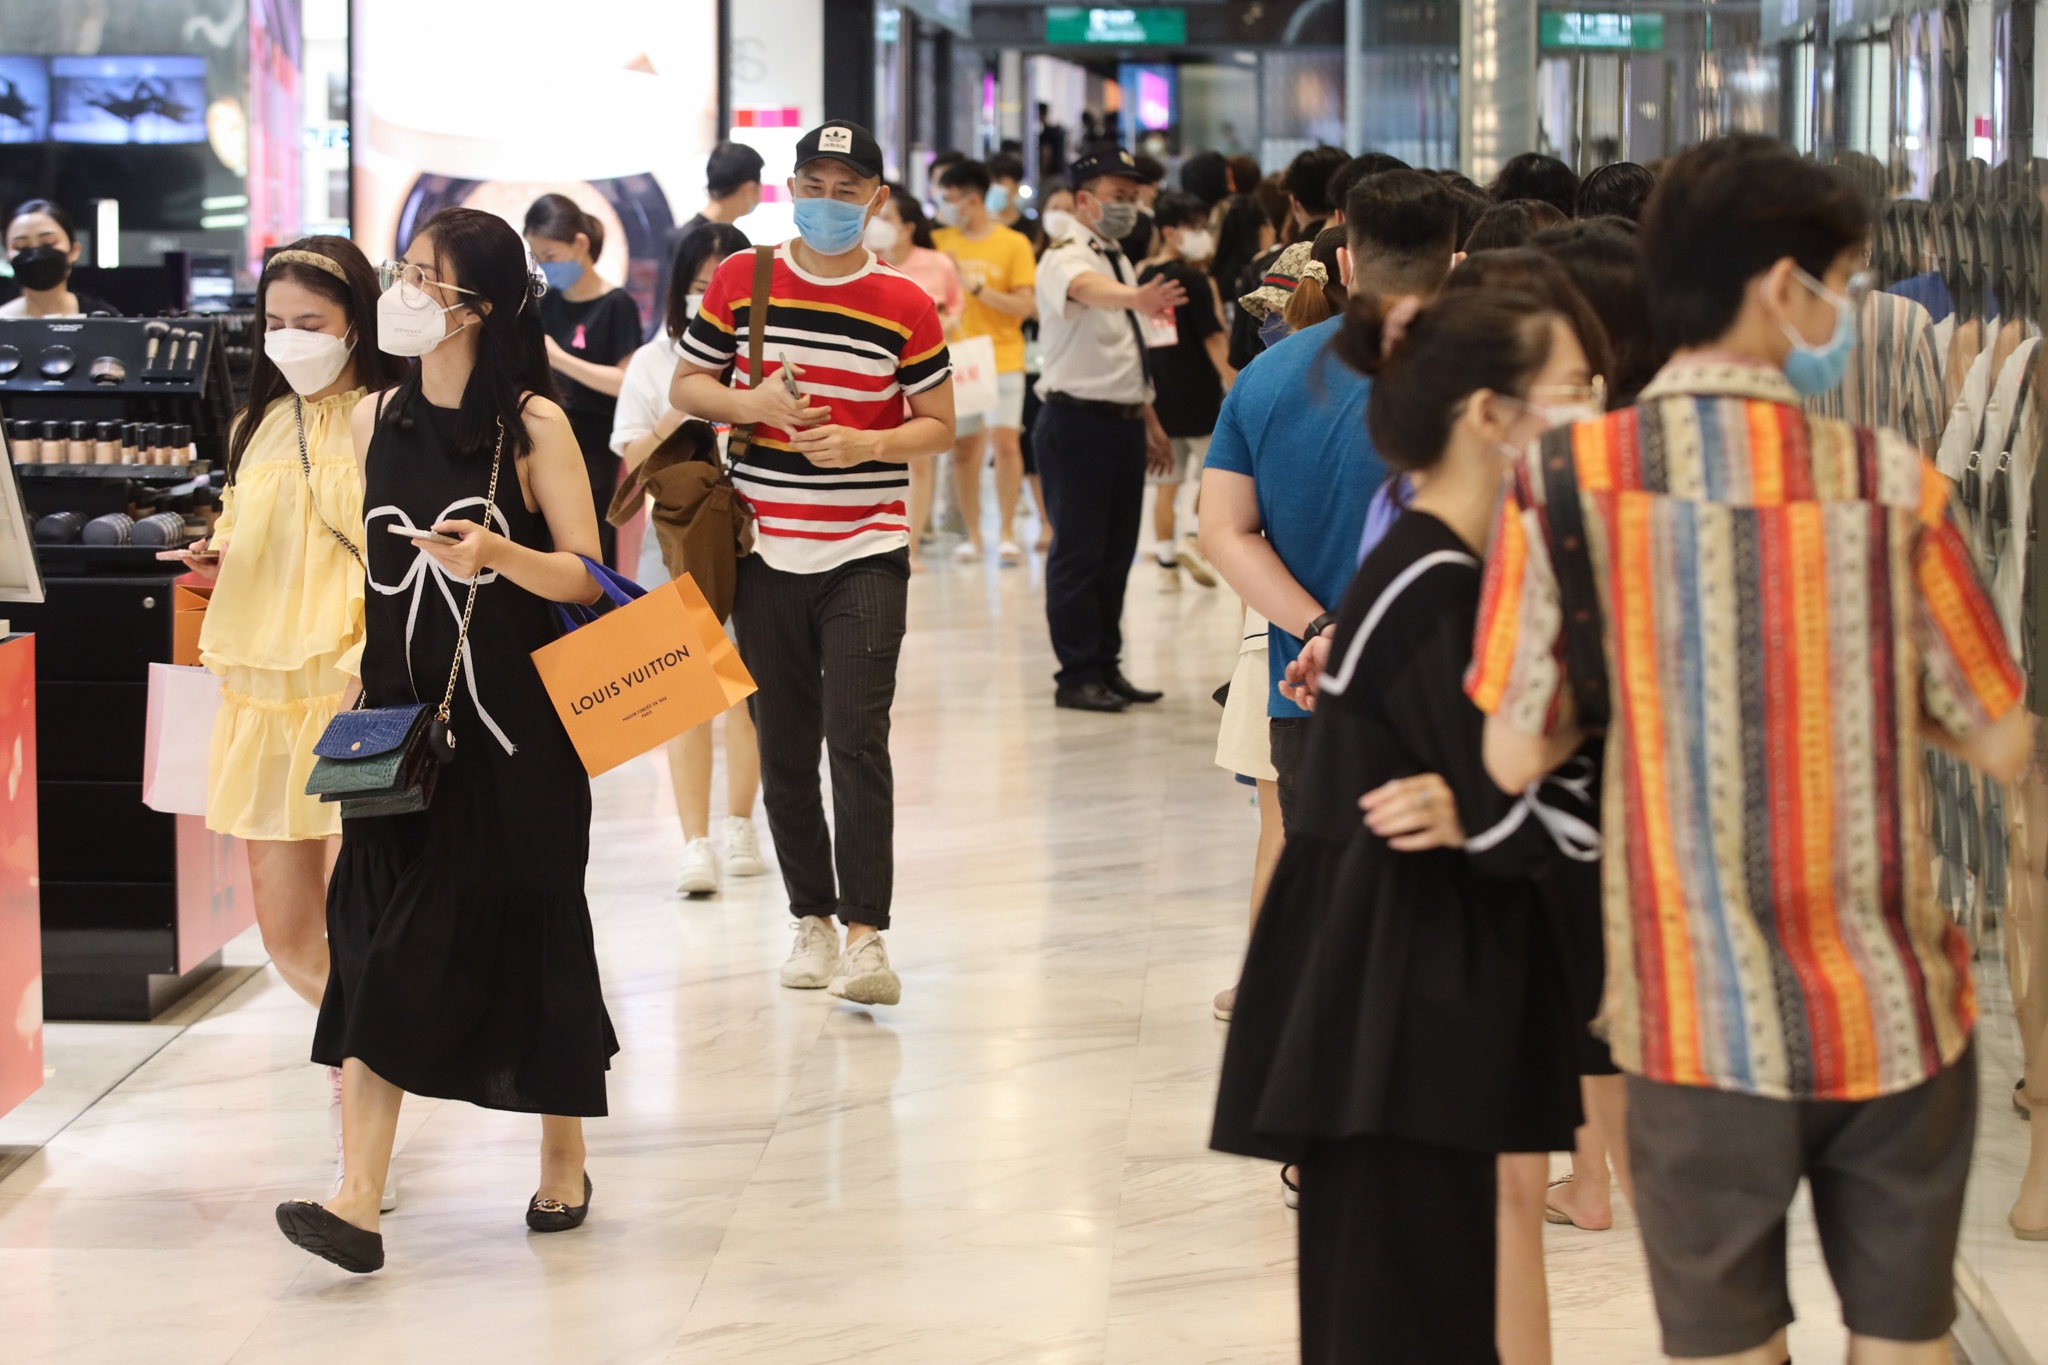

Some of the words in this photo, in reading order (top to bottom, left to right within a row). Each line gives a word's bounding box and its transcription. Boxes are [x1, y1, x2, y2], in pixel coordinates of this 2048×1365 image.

[571, 682, 621, 716] LOUIS
[621, 645, 690, 687] VUITTON
[622, 712, 637, 721] MAISON
[641, 710, 653, 718] PARIS
